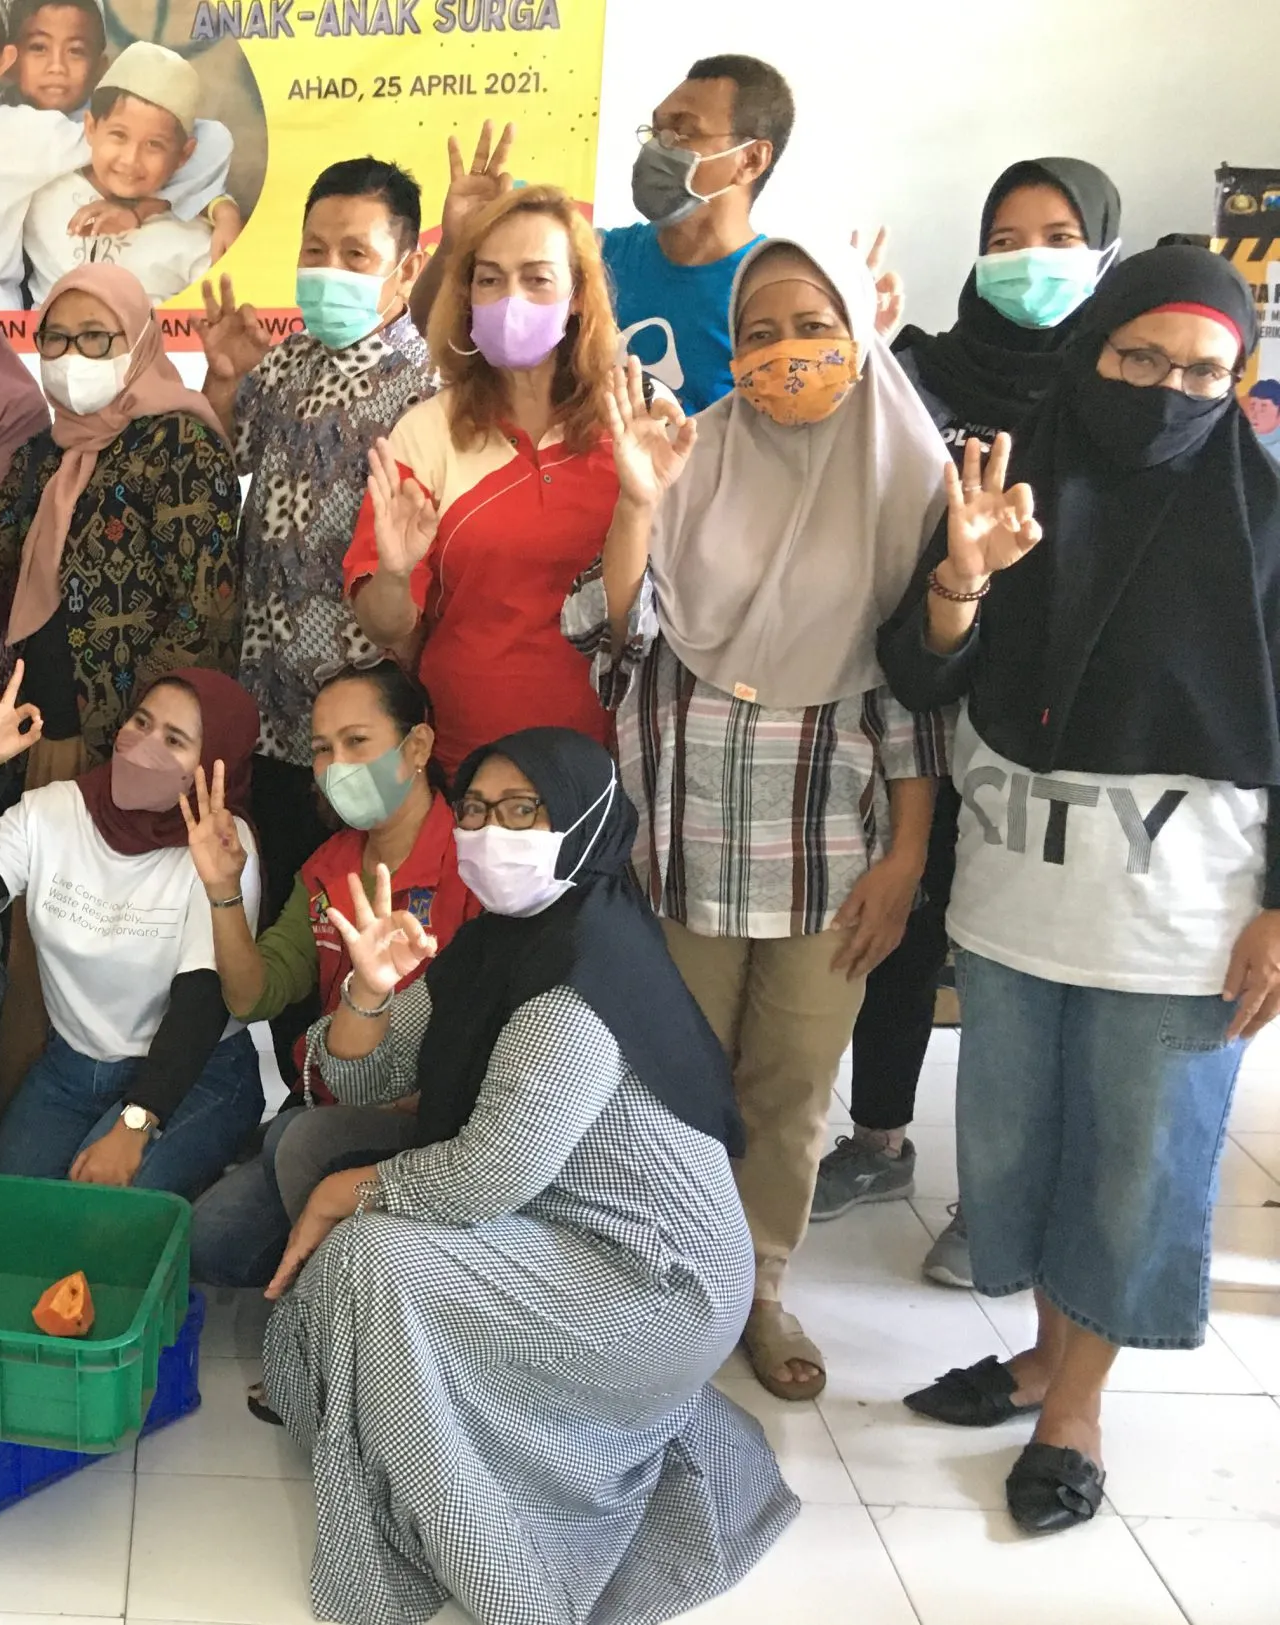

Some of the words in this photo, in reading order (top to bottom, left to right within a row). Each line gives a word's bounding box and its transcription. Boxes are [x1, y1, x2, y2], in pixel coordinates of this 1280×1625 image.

[190, 0, 422, 40] ANAK-ANAK
[433, 0, 561, 34] SURGA
[288, 77, 365, 103] AHAD,
[372, 75, 403, 98] 25
[409, 74, 477, 97] APRIL
[484, 72, 548, 95] 2021.
[42, 900, 67, 920] Keep
[49, 886, 79, 908] Waste
